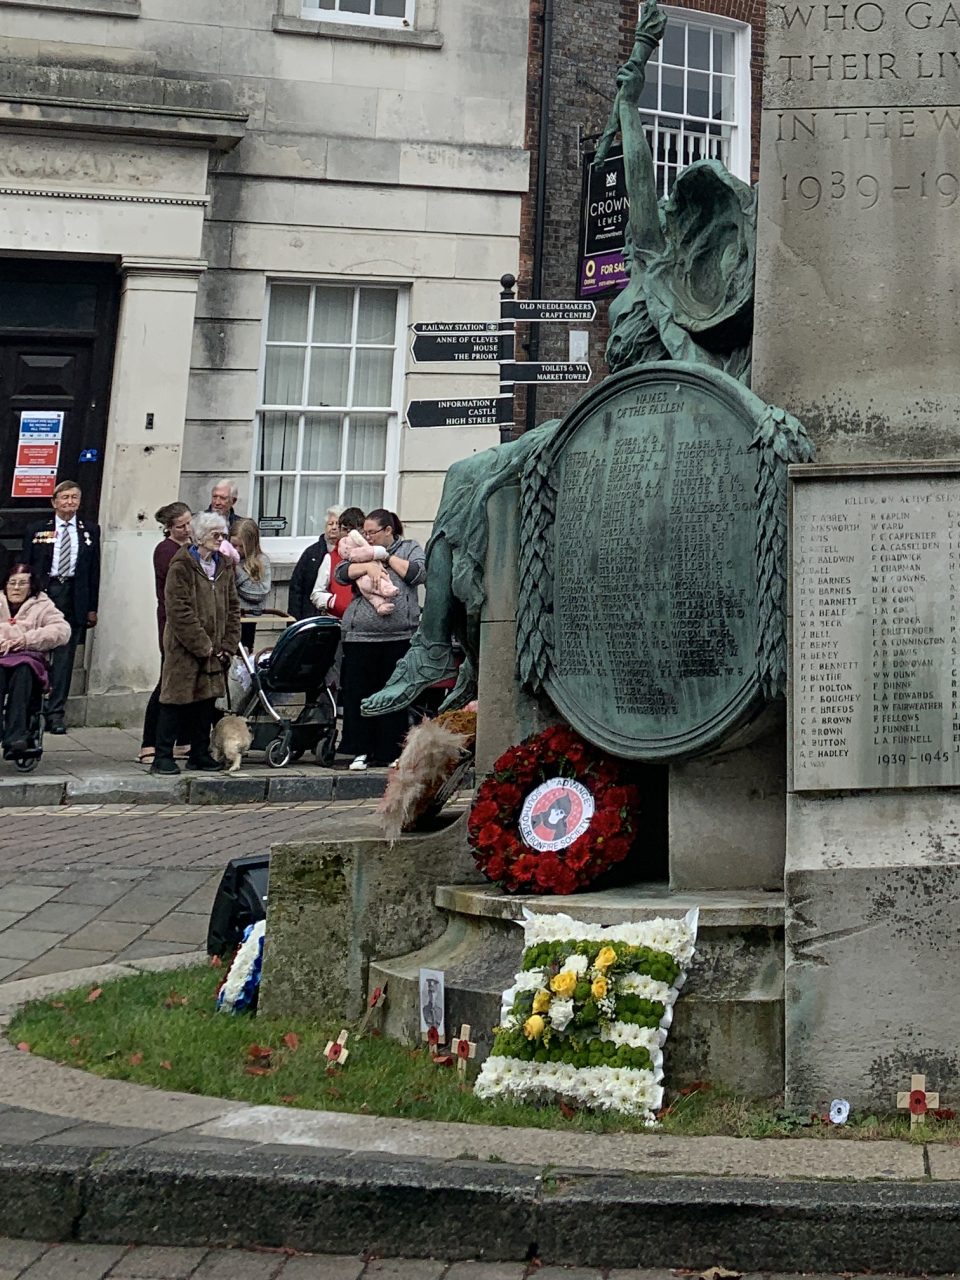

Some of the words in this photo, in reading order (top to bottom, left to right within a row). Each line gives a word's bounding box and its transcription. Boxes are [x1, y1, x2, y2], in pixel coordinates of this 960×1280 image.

[781, 1, 885, 33] WHO
[779, 52, 902, 83] THEIR
[775, 112, 817, 142] IN
[834, 110, 916, 140] THE
[590, 197, 631, 216] CROWN
[597, 214, 622, 226] LEWES
[600, 264, 613, 275] FOR
[540, 311, 563, 319] CRAFT
[564, 311, 592, 319] CENTRE
[635, 391, 668, 405] NAMES
[438, 399, 490, 408] INFORMATION
[616, 408, 628, 419] OF
[627, 406, 646, 418] THE
[648, 401, 685, 415] FALLEN
[446, 417, 466, 425] HIGH
[468, 416, 496, 424] STREET
[900, 494, 930, 504] ACTIVE
[888, 531, 937, 541] CARPENTER
[890, 542, 940, 551] CASSELDEN
[817, 555, 855, 564] BALDWIN
[879, 553, 922, 562] CHADWICK
[880, 563, 921, 573] CHAPMAN
[817, 576, 851, 585] BARNES
[818, 586, 852, 595] BARNES
[818, 597, 857, 606] BARNETT
[818, 608, 847, 617] BEALE
[809, 631, 831, 639] BELL
[890, 638, 946, 647] CUNNINGTON
[893, 649, 917, 657] DAVIS
[818, 661, 859, 671] BENNETT
[892, 658, 934, 668] DONOVAN
[893, 670, 917, 679] DUNK
[819, 683, 853, 692] BOLTON
[819, 694, 862, 703] BOUGHEY
[893, 690, 935, 700] EDWARDS
[892, 701, 944, 711] FAIRWEATHER
[821, 716, 852, 724] BROWN
[882, 713, 920, 723] FELLOWS
[811, 727, 843, 735] BROWN
[882, 724, 921, 733] FUNNELL
[811, 738, 846, 746] BUTTON
[892, 735, 933, 744] FUNNELL
[817, 749, 849, 758] HADLEY
[522, 789, 542, 837] SOUTHOVER
[560, 819, 588, 847] SOCIETY
[528, 835, 559, 850] BONFIRE
